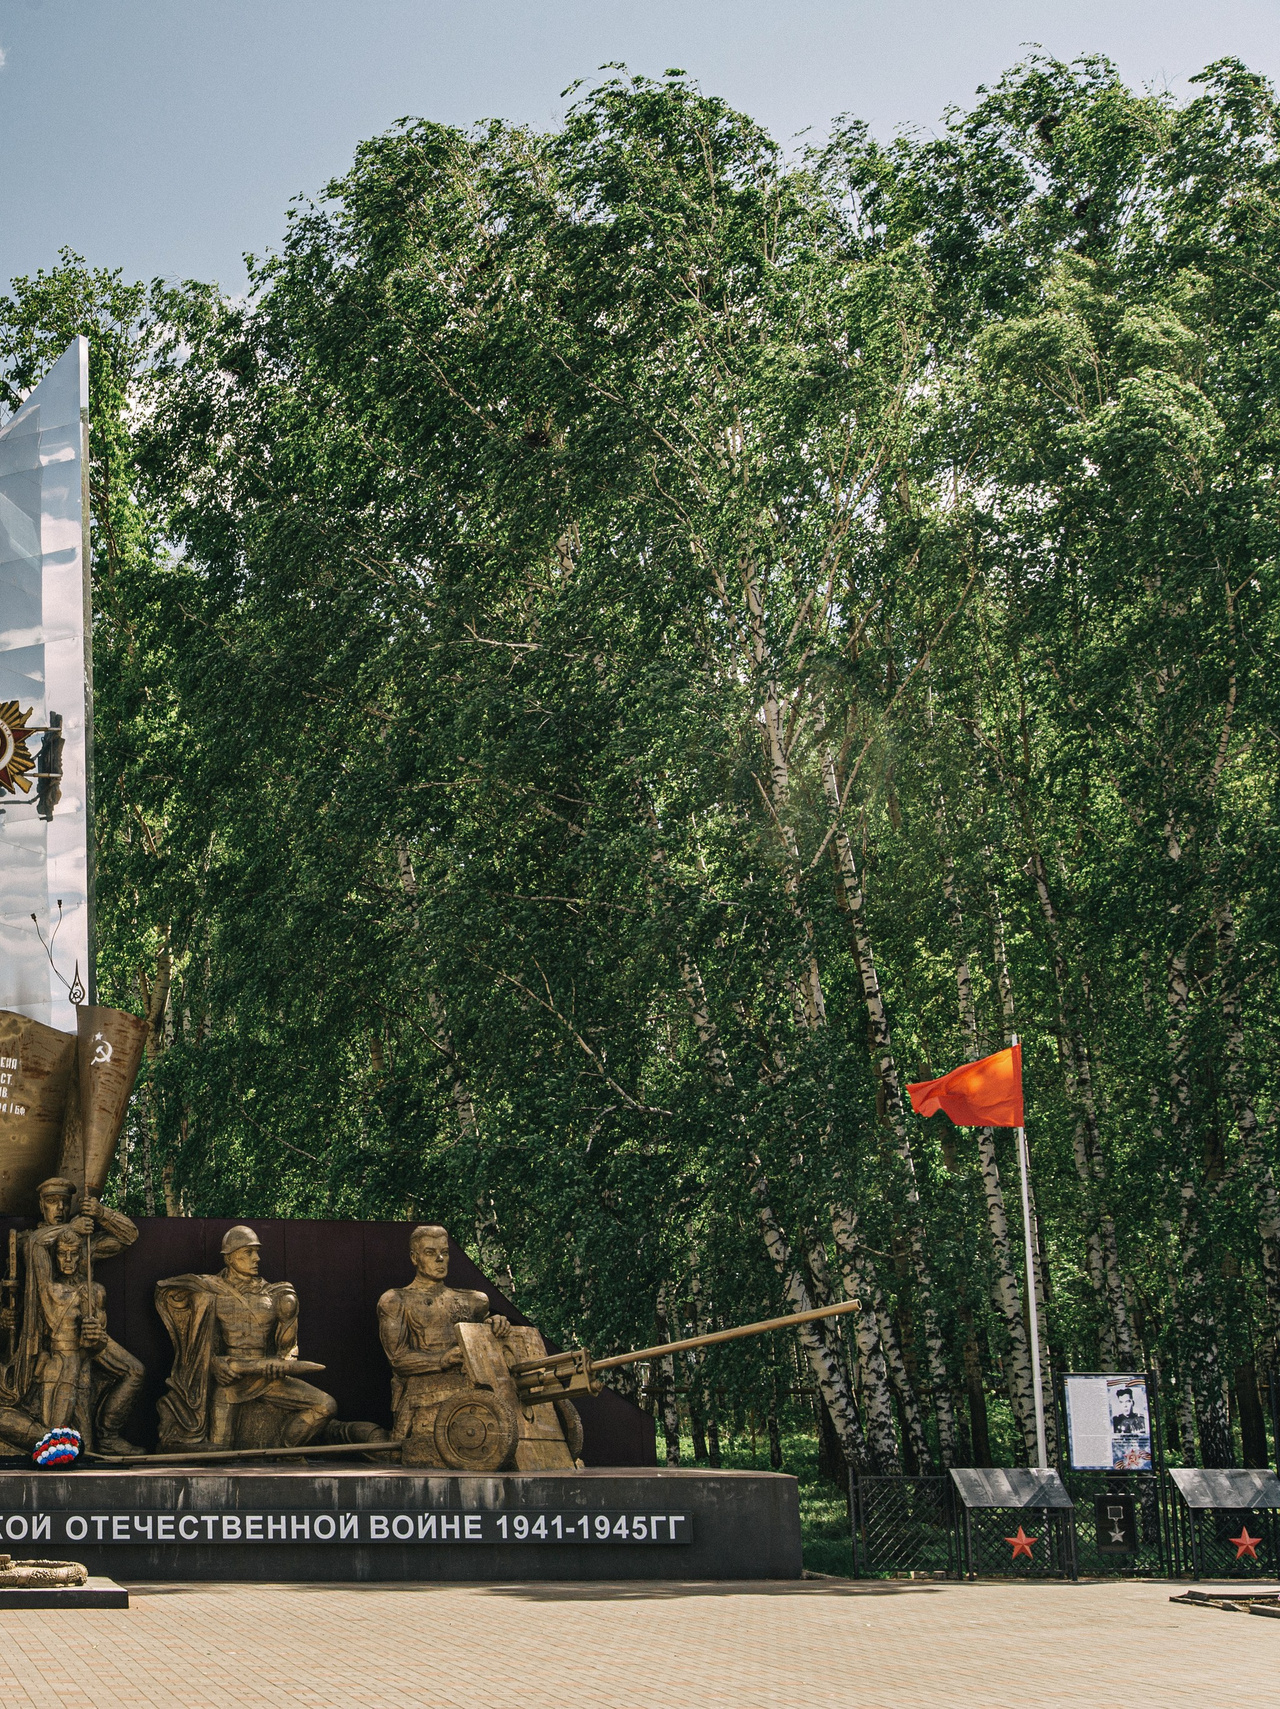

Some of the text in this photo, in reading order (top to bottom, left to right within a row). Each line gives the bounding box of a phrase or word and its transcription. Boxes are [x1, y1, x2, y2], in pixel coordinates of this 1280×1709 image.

[66, 1513, 358, 1540] ОТЕЧЕСТВЕННОЙ
[370, 1513, 482, 1539] ВОЙНЕ
[497, 1515, 685, 1539] 1941-1945ГГ
